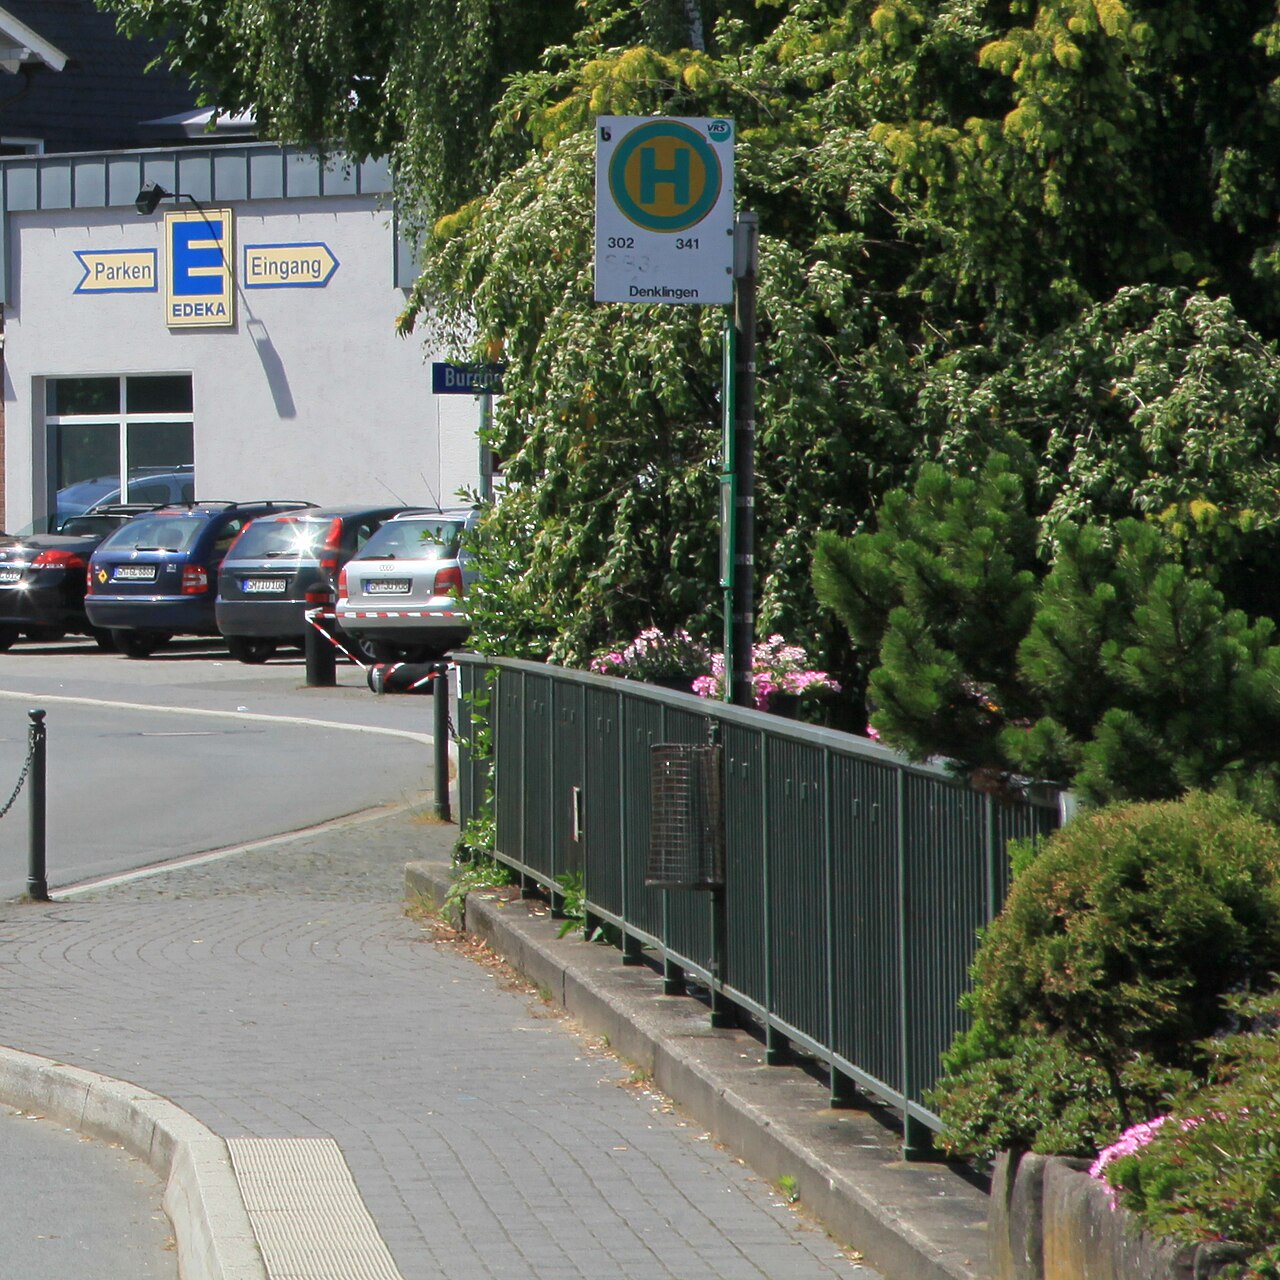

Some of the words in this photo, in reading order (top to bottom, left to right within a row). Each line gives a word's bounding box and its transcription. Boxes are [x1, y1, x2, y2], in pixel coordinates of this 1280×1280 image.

[707, 123, 726, 132] VRS
[640, 147, 690, 206] H
[607, 237, 635, 249] 302
[675, 238, 700, 250] 341
[172, 220, 224, 296] E
[94, 262, 152, 281] Parken
[251, 255, 322, 280] Eingang
[628, 285, 699, 300] Denklingen
[172, 302, 227, 318] EDEKA
